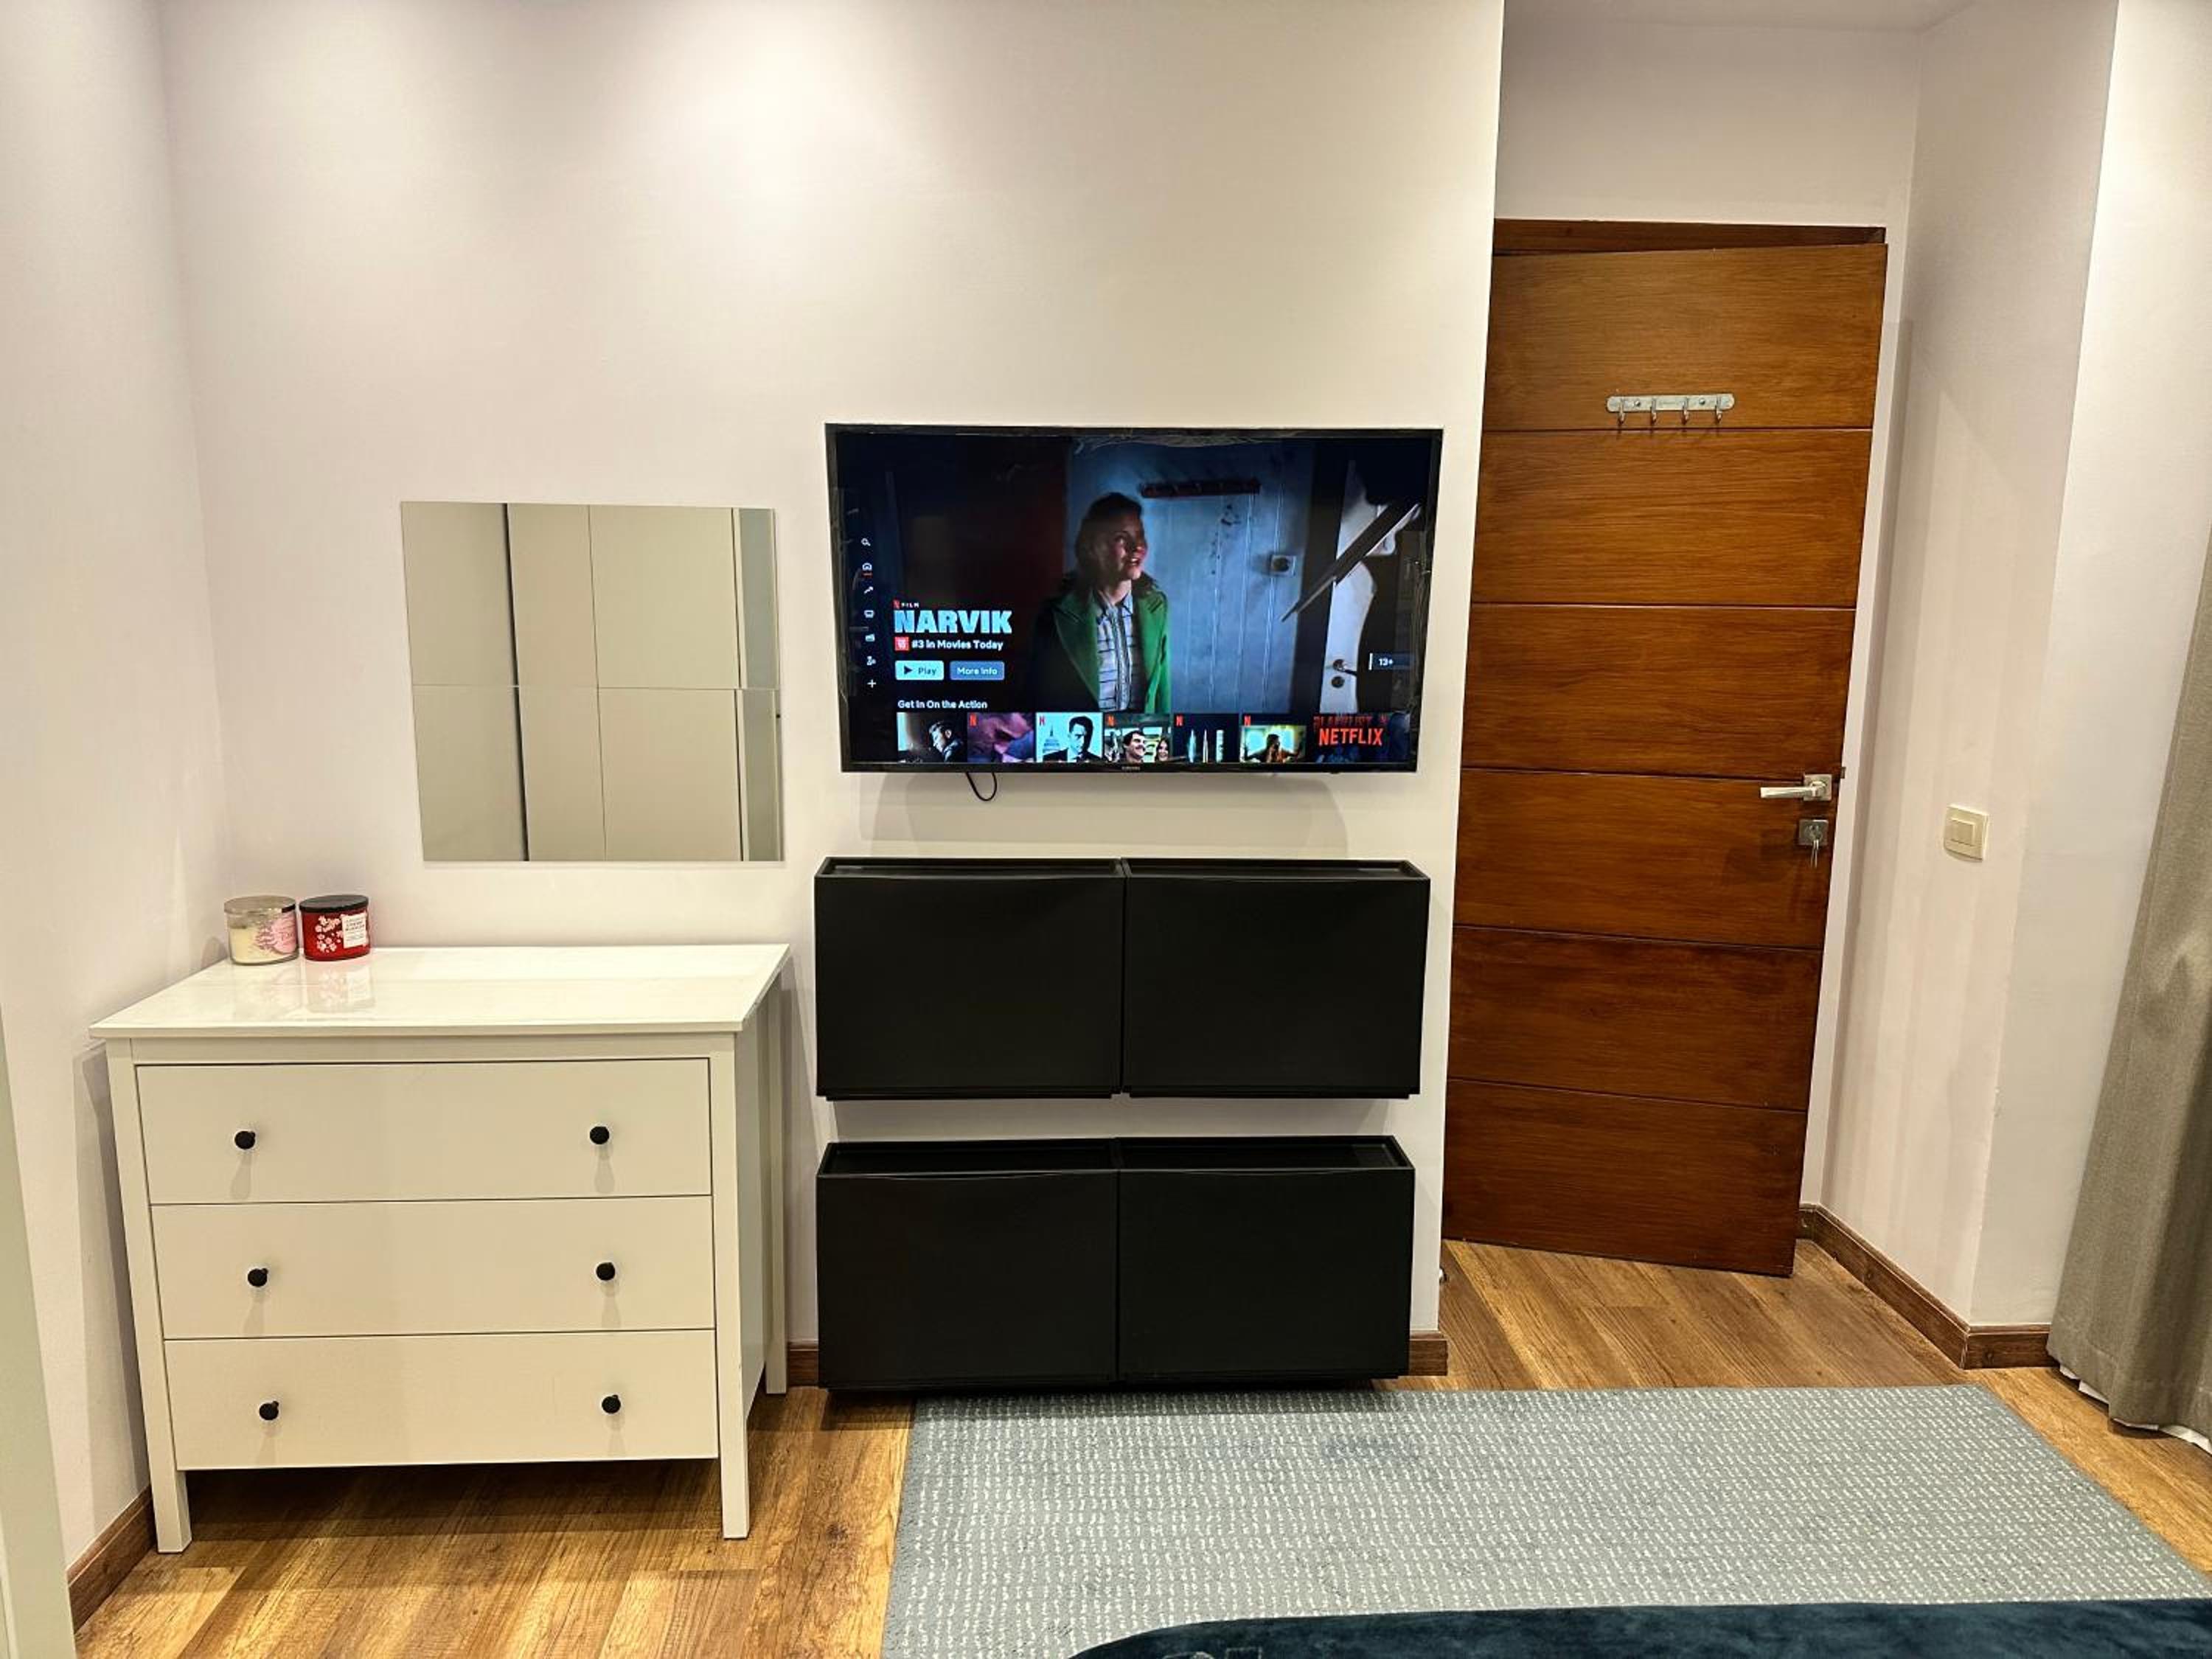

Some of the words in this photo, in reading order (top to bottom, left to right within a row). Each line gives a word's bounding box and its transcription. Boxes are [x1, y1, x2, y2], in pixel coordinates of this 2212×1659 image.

[894, 610, 1012, 633] NARVIK
[911, 639, 925, 649] #3
[937, 639, 972, 649] Movies
[973, 639, 1004, 651] Today
[918, 667, 937, 676] Play
[957, 667, 979, 675] More
[897, 700, 915, 709] Get
[926, 700, 940, 709] On
[942, 700, 957, 709] the
[958, 700, 988, 709] Action
[1318, 728, 1384, 746] NETFLIX
